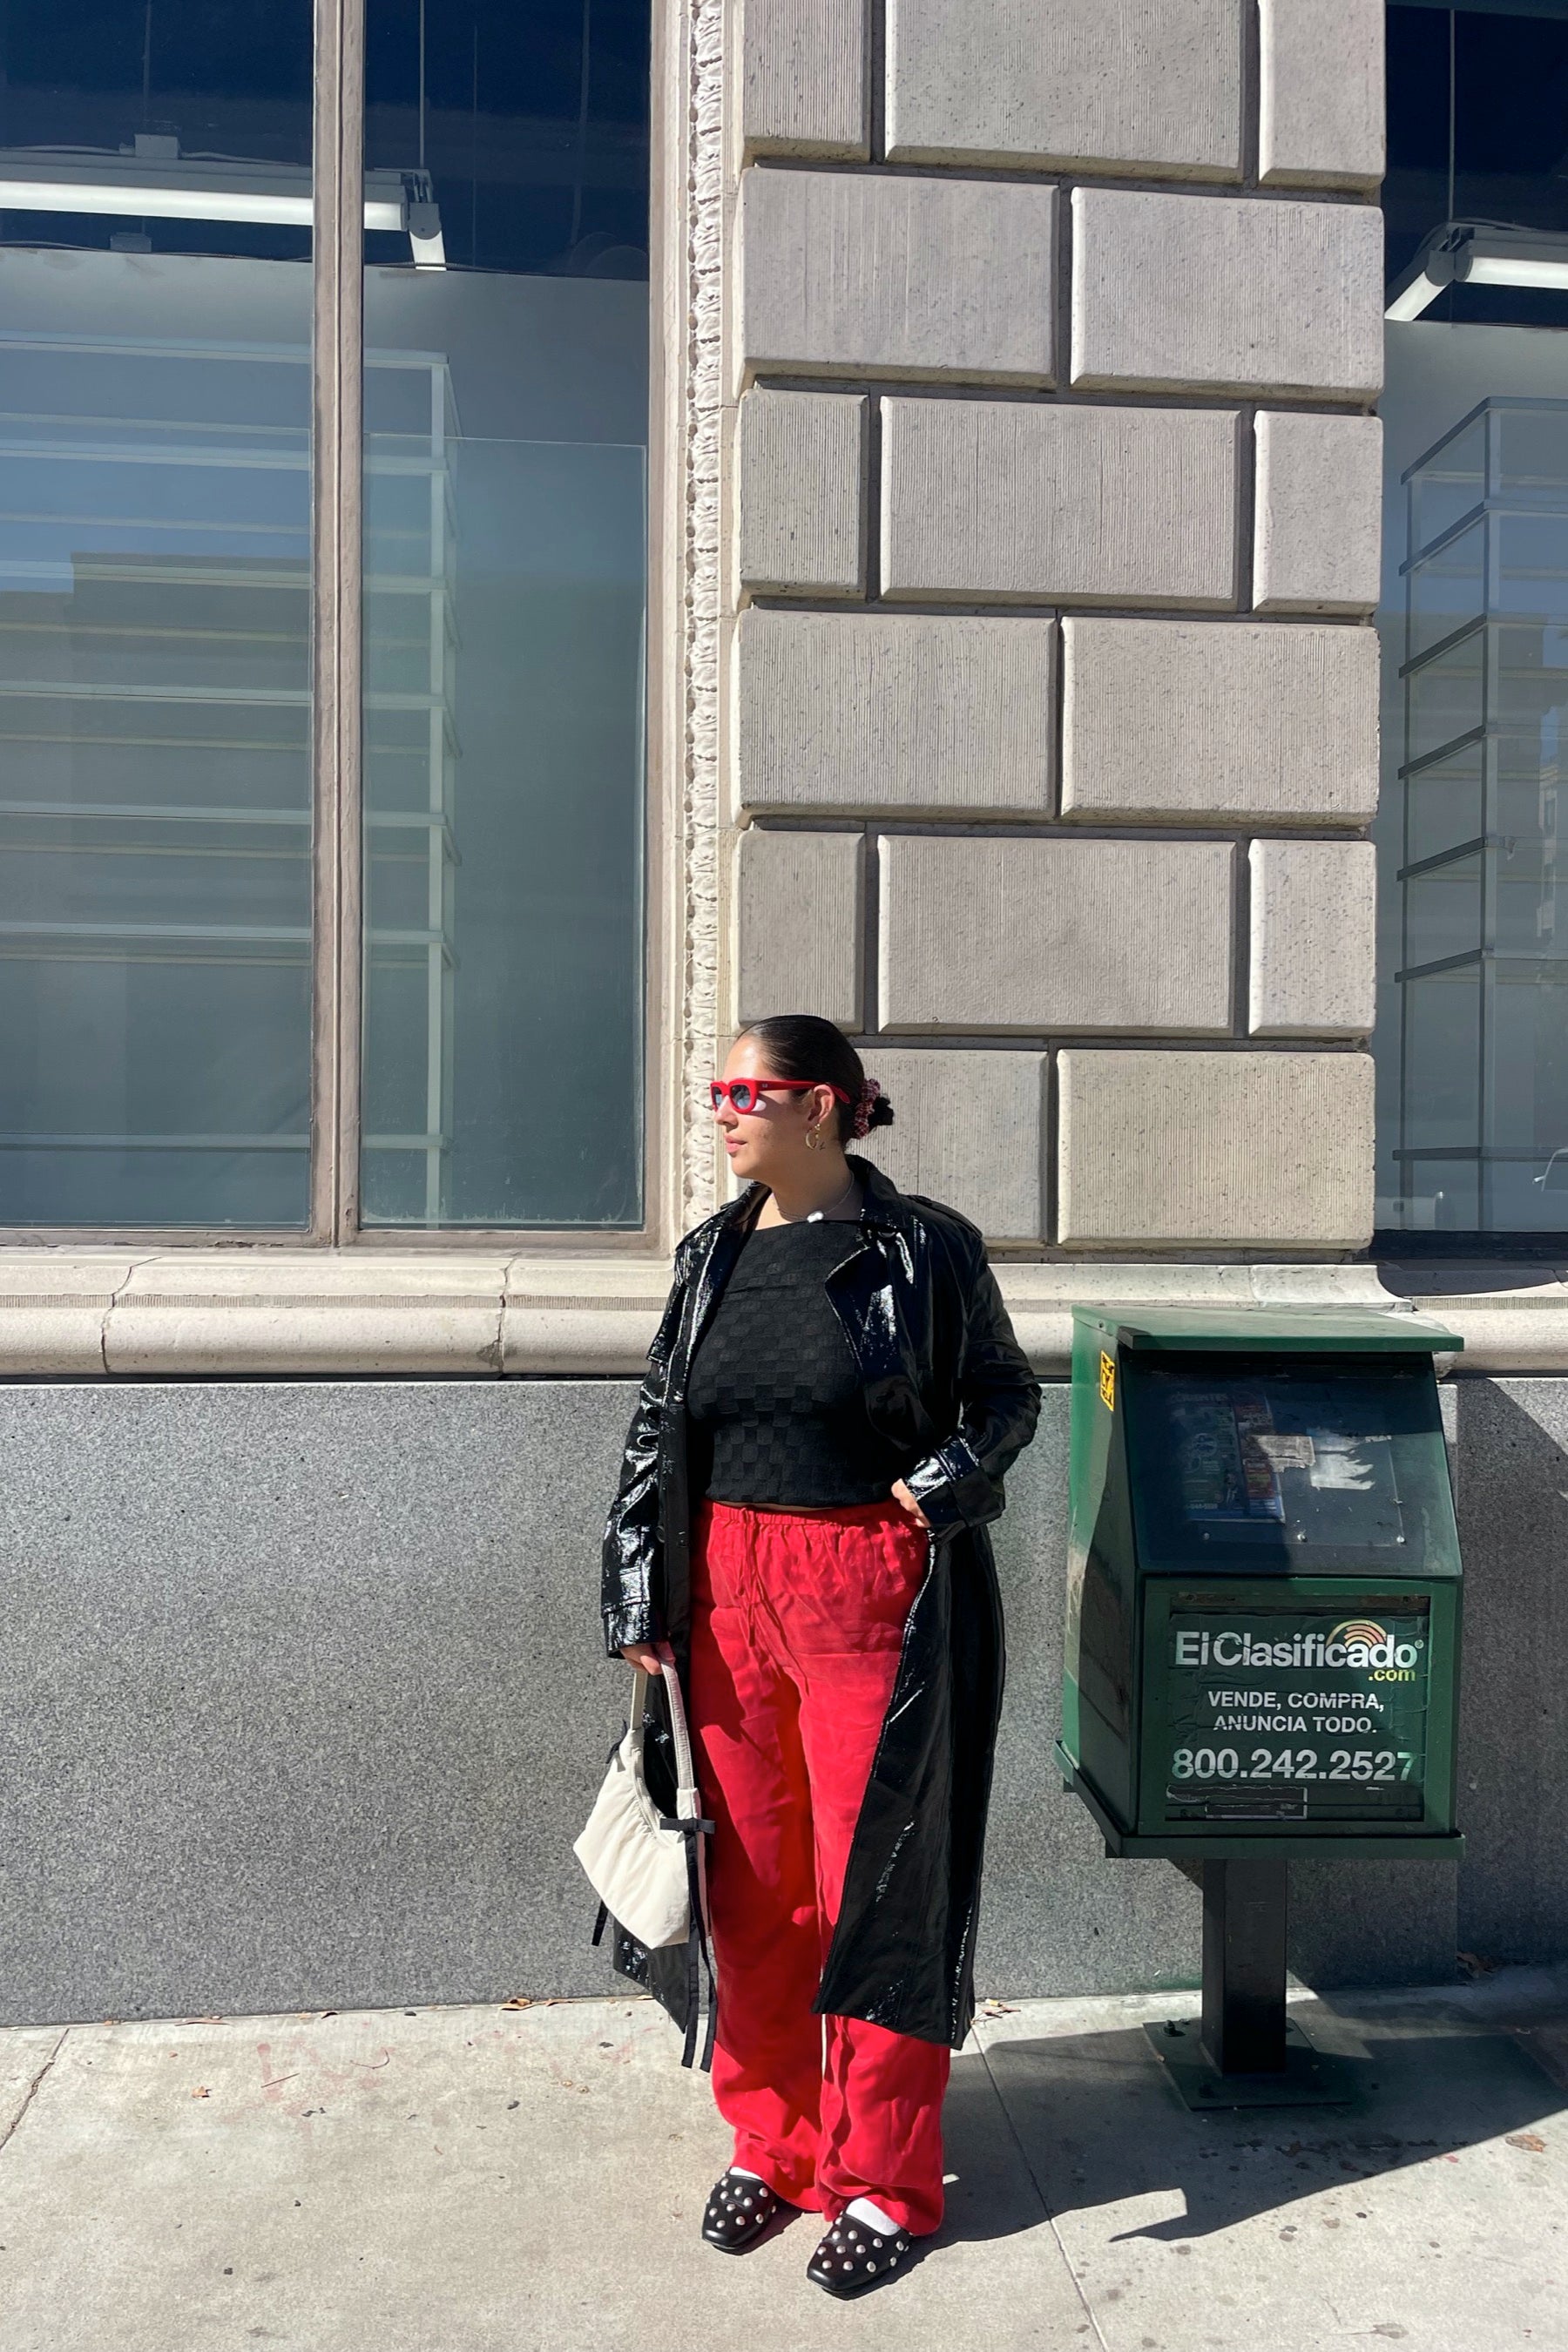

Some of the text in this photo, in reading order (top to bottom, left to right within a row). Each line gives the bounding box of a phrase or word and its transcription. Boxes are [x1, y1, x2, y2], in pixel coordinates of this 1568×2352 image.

[1368, 1669, 1416, 1682] .com
[1208, 1691, 1384, 1712] VENDE, COMPRA,
[1213, 1714, 1377, 1734] ANUNCIA TODO.
[1172, 1748, 1417, 1781] 800.242.2527
